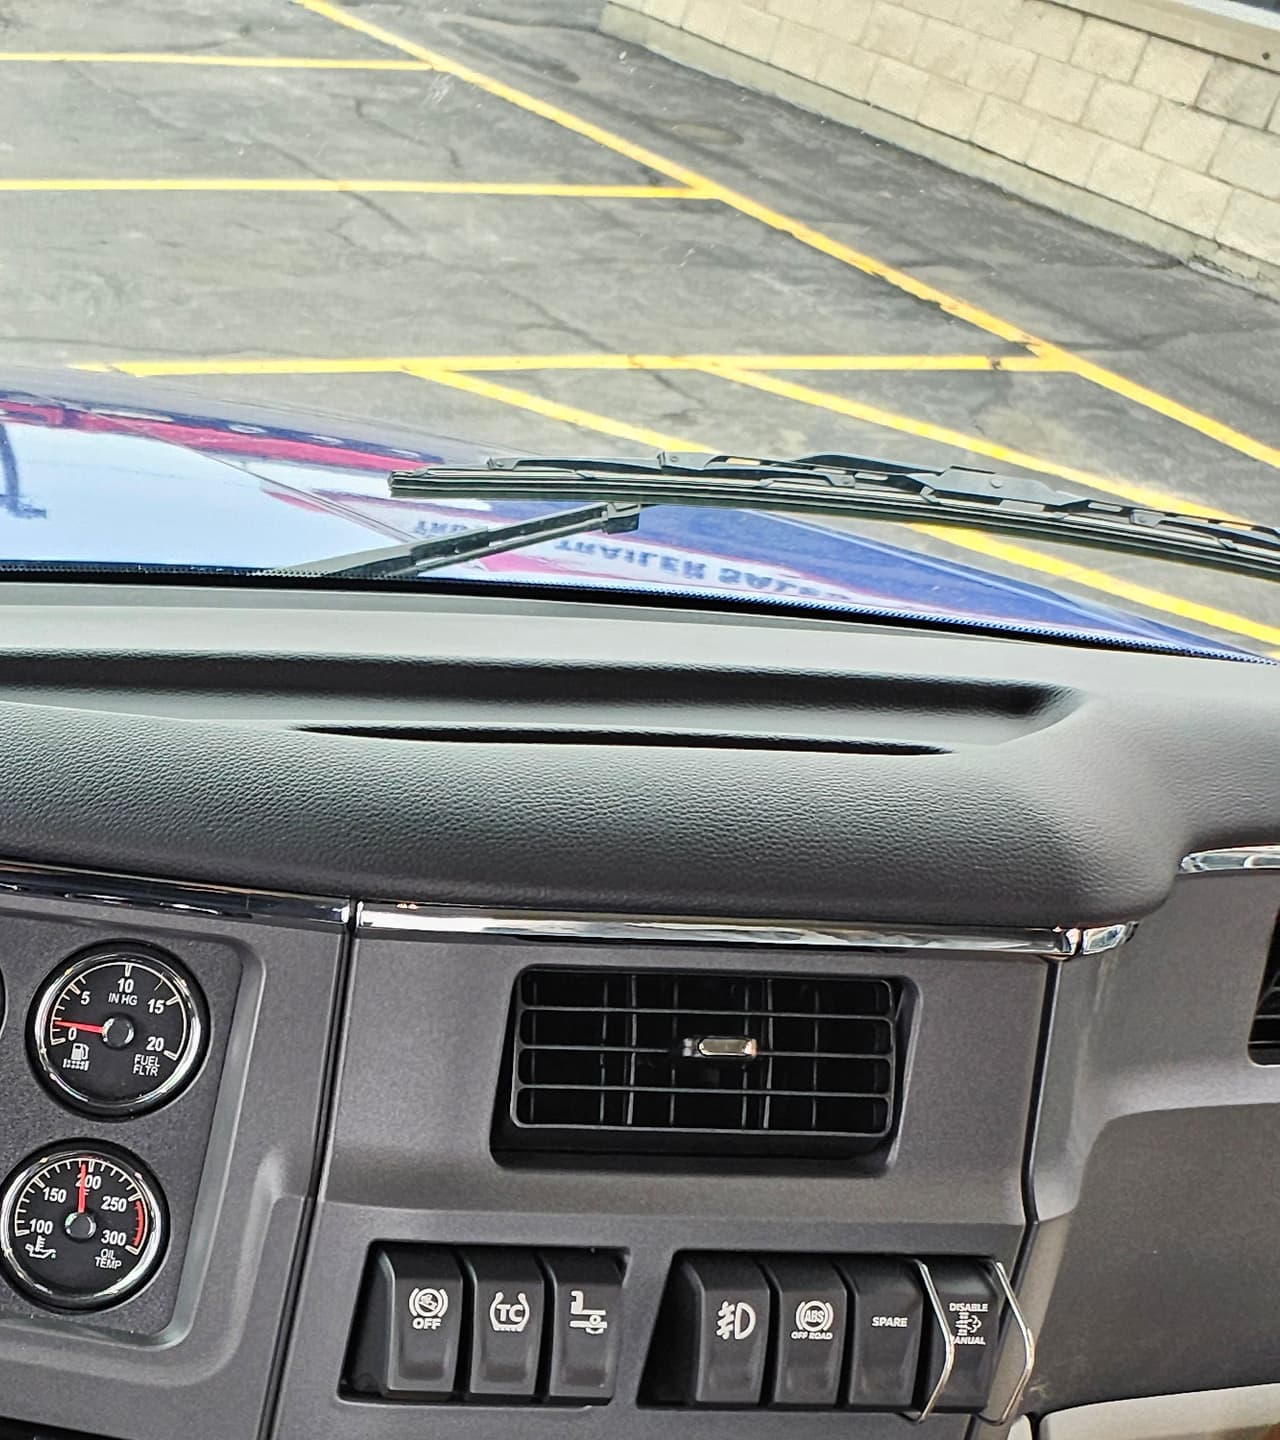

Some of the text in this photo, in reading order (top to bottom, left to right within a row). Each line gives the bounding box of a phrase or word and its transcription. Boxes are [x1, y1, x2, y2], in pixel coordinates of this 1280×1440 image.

[117, 978, 134, 993] 10
[80, 992, 90, 1004] 5
[108, 993, 138, 1005] IN HG
[147, 999, 164, 1014] 15
[68, 1027, 77, 1041] 0
[146, 1036, 164, 1052] 20
[134, 1054, 161, 1067] FUEL
[133, 1064, 158, 1077] FLTR
[42, 1187, 67, 1203] 150
[101, 1196, 127, 1212] 250
[29, 1219, 53, 1235] 100
[101, 1230, 126, 1246] 300
[101, 1248, 116, 1260] OIL
[95, 1257, 122, 1270] TEMP
[496, 1304, 524, 1323] TC
[949, 1303, 988, 1312] DISABLE
[413, 1317, 441, 1329] OFF
[804, 1310, 825, 1323] ABS
[872, 1317, 908, 1328] SPARE
[791, 1331, 833, 1340] OFF ROAD
[951, 1335, 986, 1345] ANUAL
